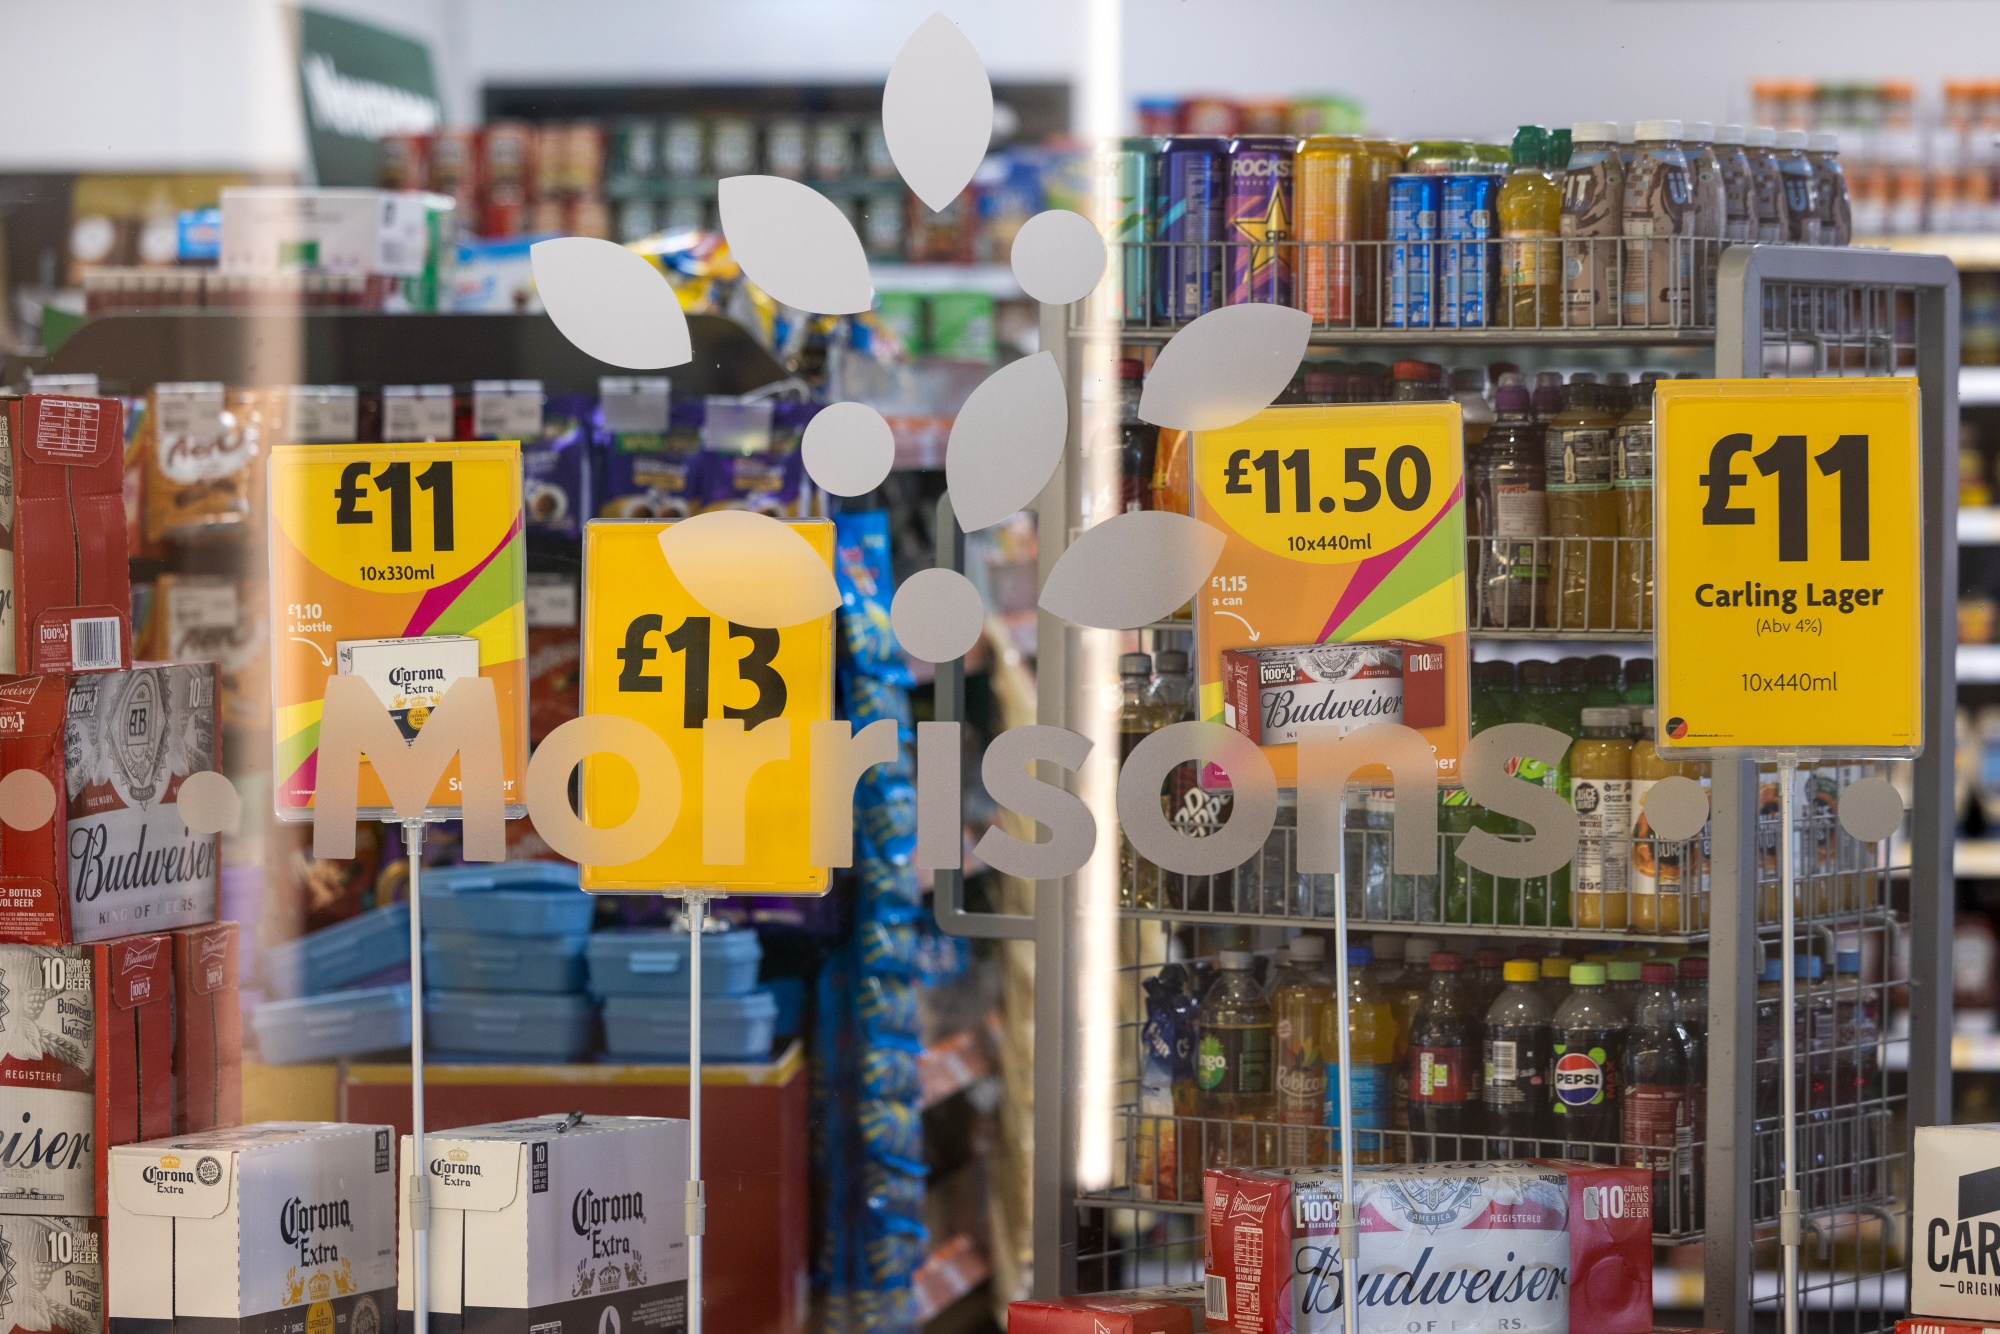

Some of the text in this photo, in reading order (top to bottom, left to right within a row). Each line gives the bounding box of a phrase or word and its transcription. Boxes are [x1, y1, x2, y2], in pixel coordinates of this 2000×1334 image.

[0, 436, 9, 448] ER
[1224, 445, 1431, 514] £11.50
[1699, 432, 1870, 562] £11
[334, 461, 455, 552] £11
[1288, 533, 1372, 551] 10x440ml
[360, 564, 435, 582] 10x330ml
[1212, 576, 1247, 592] £1.15
[1212, 596, 1243, 606] a can
[1695, 582, 1883, 614] Carling Lager
[288, 604, 322, 619] £1.10
[43, 628, 65, 640] 100%
[288, 621, 332, 633] a bottle
[1756, 618, 1822, 637] (Abv 4%)
[1417, 653, 1430, 671] 10
[389, 667, 445, 687] Corona
[617, 614, 787, 731] £13
[1264, 668, 1291, 681] 100%
[405, 683, 434, 694] Extra
[1741, 671, 1838, 692] 10x440ml
[189, 677, 200, 708] 10
[1261, 689, 1403, 729] Budweiser
[313, 675, 1579, 880] Morrisons
[449, 777, 514, 792] Suer
[70, 823, 215, 903] Budweiser
[9, 888, 42, 898] BOTTLES
[14, 898, 34, 908] BEER
[134, 904, 151, 919] OF
[42, 957, 66, 990] 10
[66, 965, 91, 974] BOTTLES
[66, 978, 91, 991] BEER
[1199, 1054, 1226, 1071] ngo
[5, 1069, 62, 1082] REGISTERED
[1556, 1073, 1599, 1085] PEPSI
[1606, 1061, 1615, 1099] MAX
[378, 1133, 387, 1150] 10
[535, 1145, 545, 1163] 10
[143, 1166, 195, 1185] Corona
[430, 1158, 481, 1178] Corona
[157, 1182, 184, 1194] Extra
[444, 1175, 471, 1187] Extra
[1233, 1197, 1266, 1213] Budweiser
[1600, 1185, 1624, 1219] 10
[1624, 1193, 1649, 1203] CANS
[572, 1188, 644, 1240] Corona
[1360, 1217, 1373, 1226] RK
[1412, 1212, 1451, 1222] AMERICA
[1490, 1214, 1541, 1223] REGISTERED
[1624, 1208, 1649, 1219] BEER
[281, 1196, 351, 1249] Corona
[1308, 1221, 1339, 1229] ELECTRICI
[48, 1231, 72, 1263] 10
[73, 1239, 98, 1247] BOTTLES
[592, 1229, 630, 1259] Extra
[73, 1251, 98, 1264] BEER
[300, 1237, 338, 1268] Extra
[1296, 1245, 1567, 1314] Budweiser
[316, 1307, 324, 1317] LA
[292, 1322, 304, 1334] SINCE
[308, 1316, 332, 1329] CERVEZA
[1406, 1320, 1437, 1334] OF
